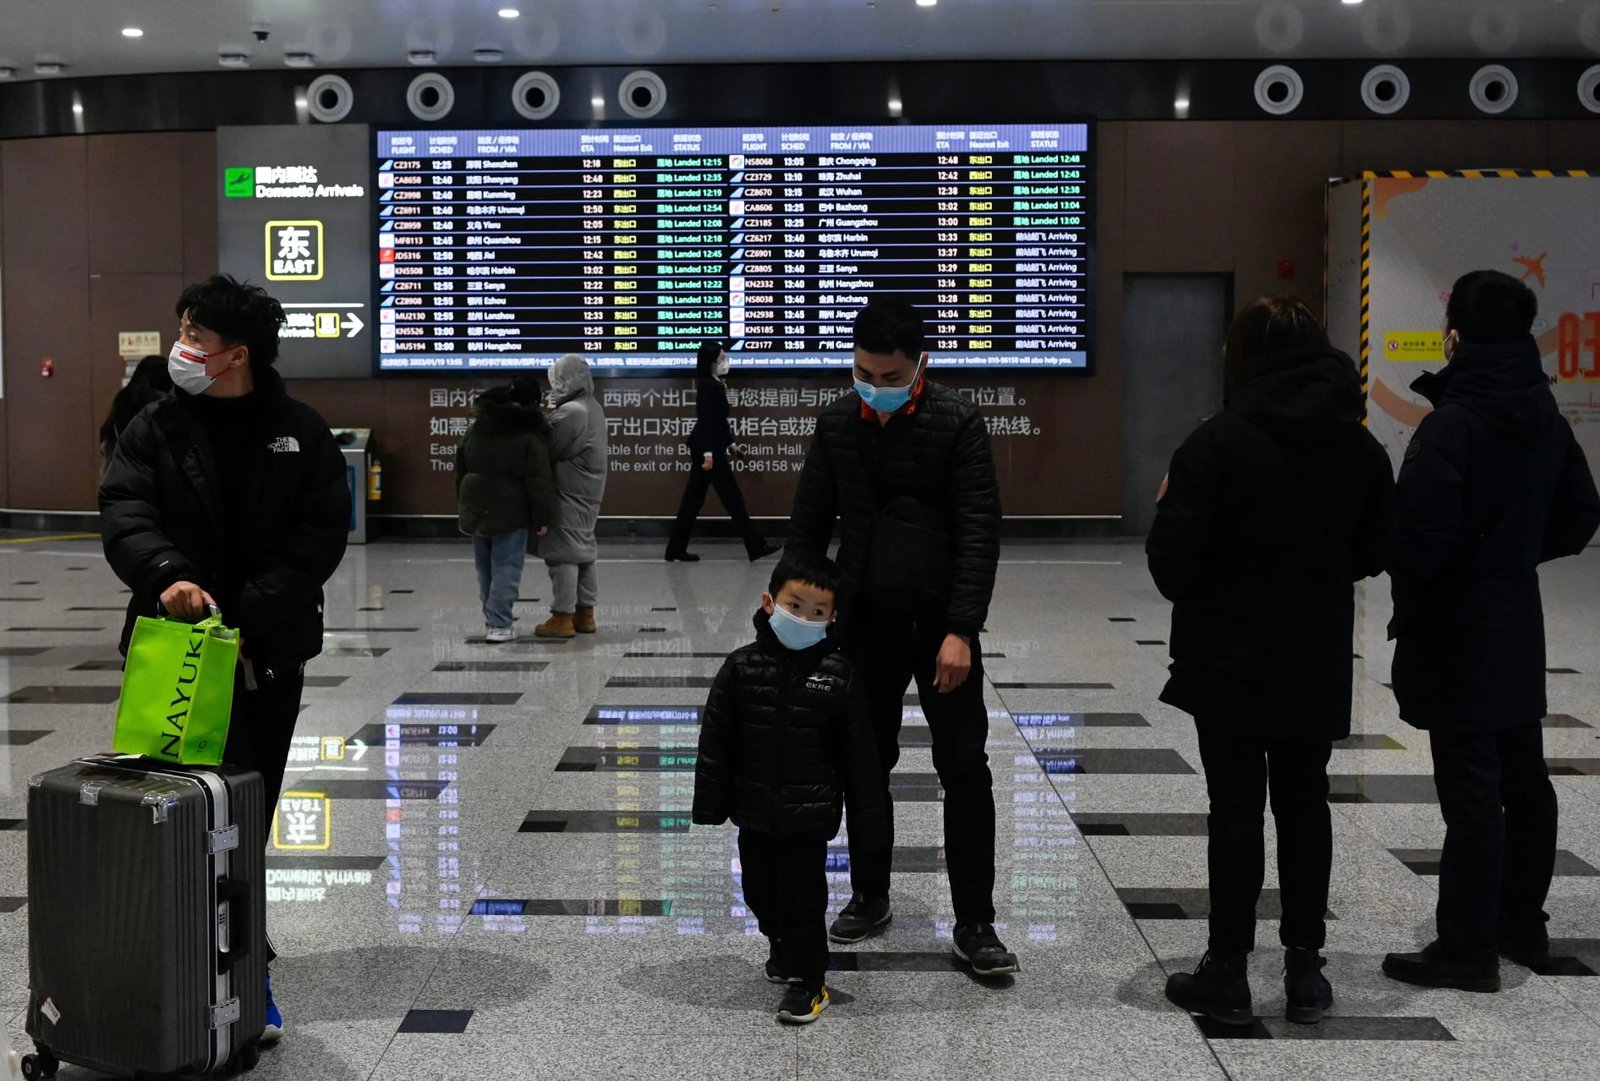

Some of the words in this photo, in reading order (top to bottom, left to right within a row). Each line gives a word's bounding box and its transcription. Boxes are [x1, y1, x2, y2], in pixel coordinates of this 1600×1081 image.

[614, 144, 639, 152] Nearest
[640, 144, 653, 152] Exit
[674, 143, 700, 151] STATUS
[781, 142, 805, 150] SCHED
[830, 142, 851, 150] FROM
[858, 142, 870, 150] VIA
[936, 141, 949, 149] ETA
[969, 141, 996, 149] Nearest
[997, 141, 1009, 149] Exit
[1031, 140, 1057, 148] STATUS
[392, 146, 415, 154] FLIGHT
[429, 146, 452, 154] SCHED
[478, 145, 498, 153] FROM
[504, 145, 517, 153] VIA
[703, 158, 722, 166] 12:15
[1031, 155, 1058, 163] Landed
[583, 160, 601, 168] 12:18
[583, 175, 603, 183] 12:48
[256, 185, 313, 198] Domestic
[315, 184, 364, 198] Arrivals
[583, 190, 602, 198] 12:23
[674, 189, 701, 197] Landed
[938, 187, 958, 195] 12:38
[1031, 186, 1058, 194] Landed
[583, 205, 603, 213] 12:50
[674, 204, 701, 212] Landed
[703, 204, 722, 212] 12:54
[938, 202, 958, 210] 13:02
[583, 220, 603, 228] 12:05
[938, 218, 958, 226] 13:00
[1031, 217, 1058, 225] Landed
[584, 236, 601, 244] 12:15
[938, 233, 957, 241] 13:33
[1048, 233, 1077, 242] Arriving
[278, 226, 310, 259] 东
[584, 251, 603, 259] 12:42
[675, 250, 701, 258] Landed
[703, 250, 722, 258] 12:45
[938, 248, 957, 256] 13:37
[1048, 248, 1077, 257] Arriving
[274, 260, 315, 274] EAST
[584, 266, 603, 274] 13:02
[703, 265, 722, 273] 12:57
[938, 264, 957, 272] 13:29
[1048, 263, 1077, 273] Arriving
[584, 281, 603, 289] 12:22
[938, 279, 955, 287] 13:16
[1048, 279, 1077, 288] Arriving
[584, 296, 603, 304] 12:28
[938, 295, 957, 303] 13:28
[1048, 294, 1077, 303] Arriving
[584, 312, 603, 320] 12:33
[675, 311, 701, 319] Landed
[1048, 309, 1077, 319] Arriving
[584, 327, 603, 335] 12:25
[704, 326, 722, 334] 12:24
[938, 325, 955, 333] 13:19
[1048, 325, 1077, 334] Arriving
[584, 342, 601, 350] 12:31
[938, 340, 957, 348] 13:35
[1048, 340, 1077, 349] Arriving
[635, 444, 650, 455] for
[654, 444, 674, 455] the
[430, 460, 454, 472] The
[611, 460, 630, 472] the
[634, 460, 655, 472] exit
[659, 463, 672, 472] or
[730, 460, 788, 472] 10-96158
[160, 626, 206, 758] NAYUKI
